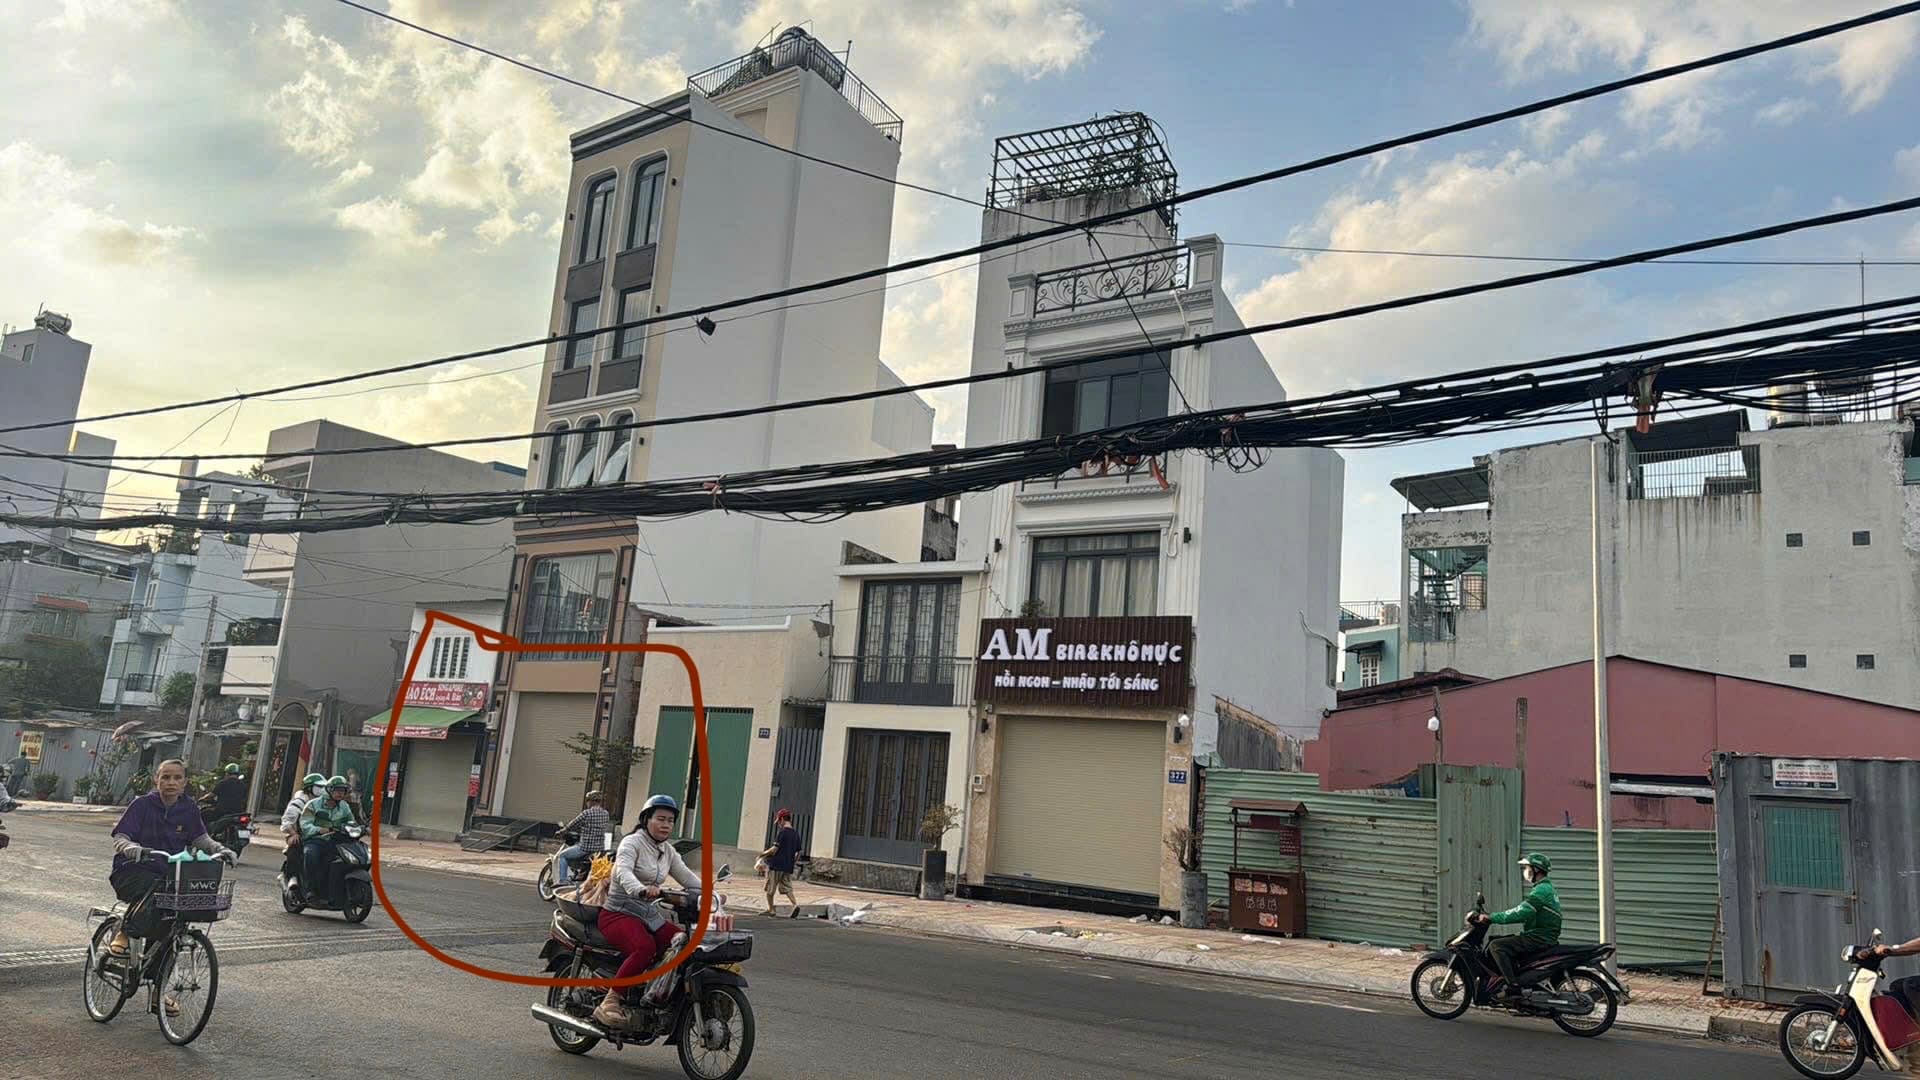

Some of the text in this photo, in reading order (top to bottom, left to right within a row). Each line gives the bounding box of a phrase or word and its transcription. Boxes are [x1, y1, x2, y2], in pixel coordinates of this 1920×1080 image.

[981, 628, 1052, 660] AM
[1018, 675, 1051, 688] NGON
[1063, 673, 1096, 692] NHẬU
[1100, 672, 1121, 690] TỚI
[1124, 672, 1159, 691] SÁNG
[1169, 771, 1185, 779] 377
[190, 881, 216, 890] MWC
